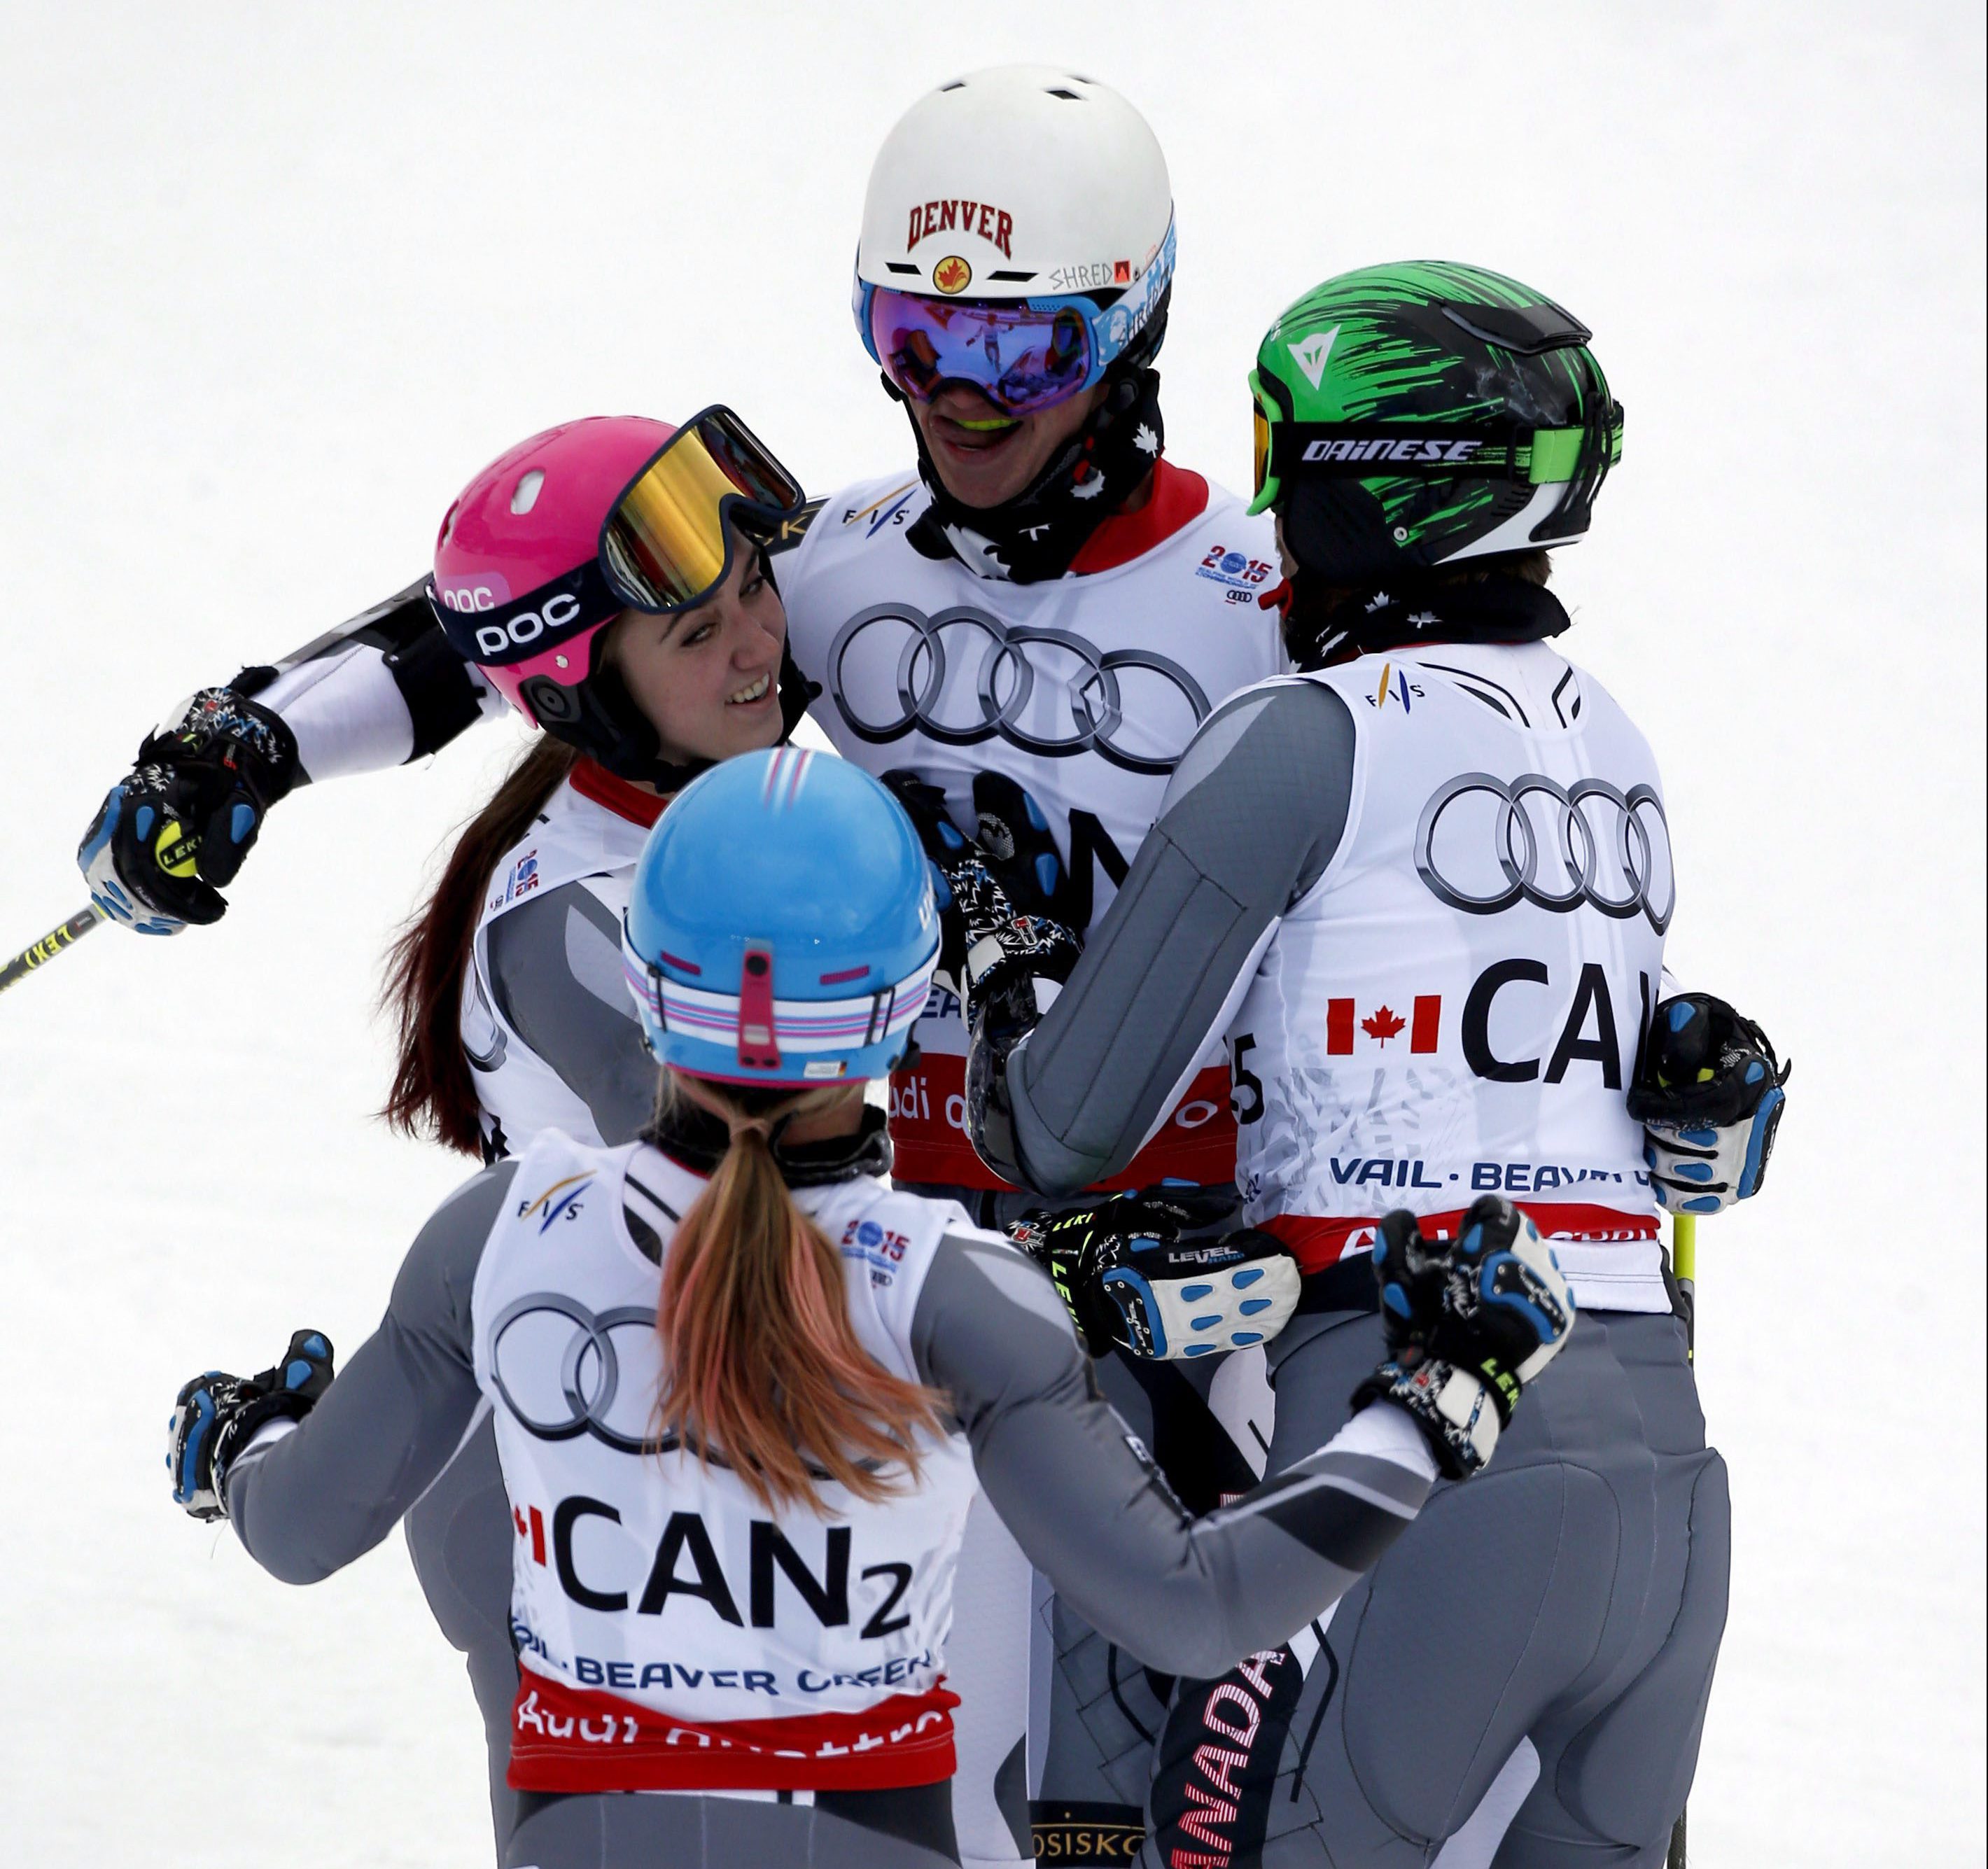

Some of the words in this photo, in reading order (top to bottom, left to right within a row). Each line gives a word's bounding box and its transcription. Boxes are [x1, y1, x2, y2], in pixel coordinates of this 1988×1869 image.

[907, 200, 1013, 260] DENVER
[1049, 262, 1113, 290] SHRED
[475, 594, 580, 656] POC
[888, 1075, 930, 1120] udi
[1330, 1158, 1442, 1188] VAIL
[1168, 1246, 1238, 1264] LEVEL
[1480, 1357, 1520, 1413] LEK
[575, 1656, 779, 1695] BEAVER
